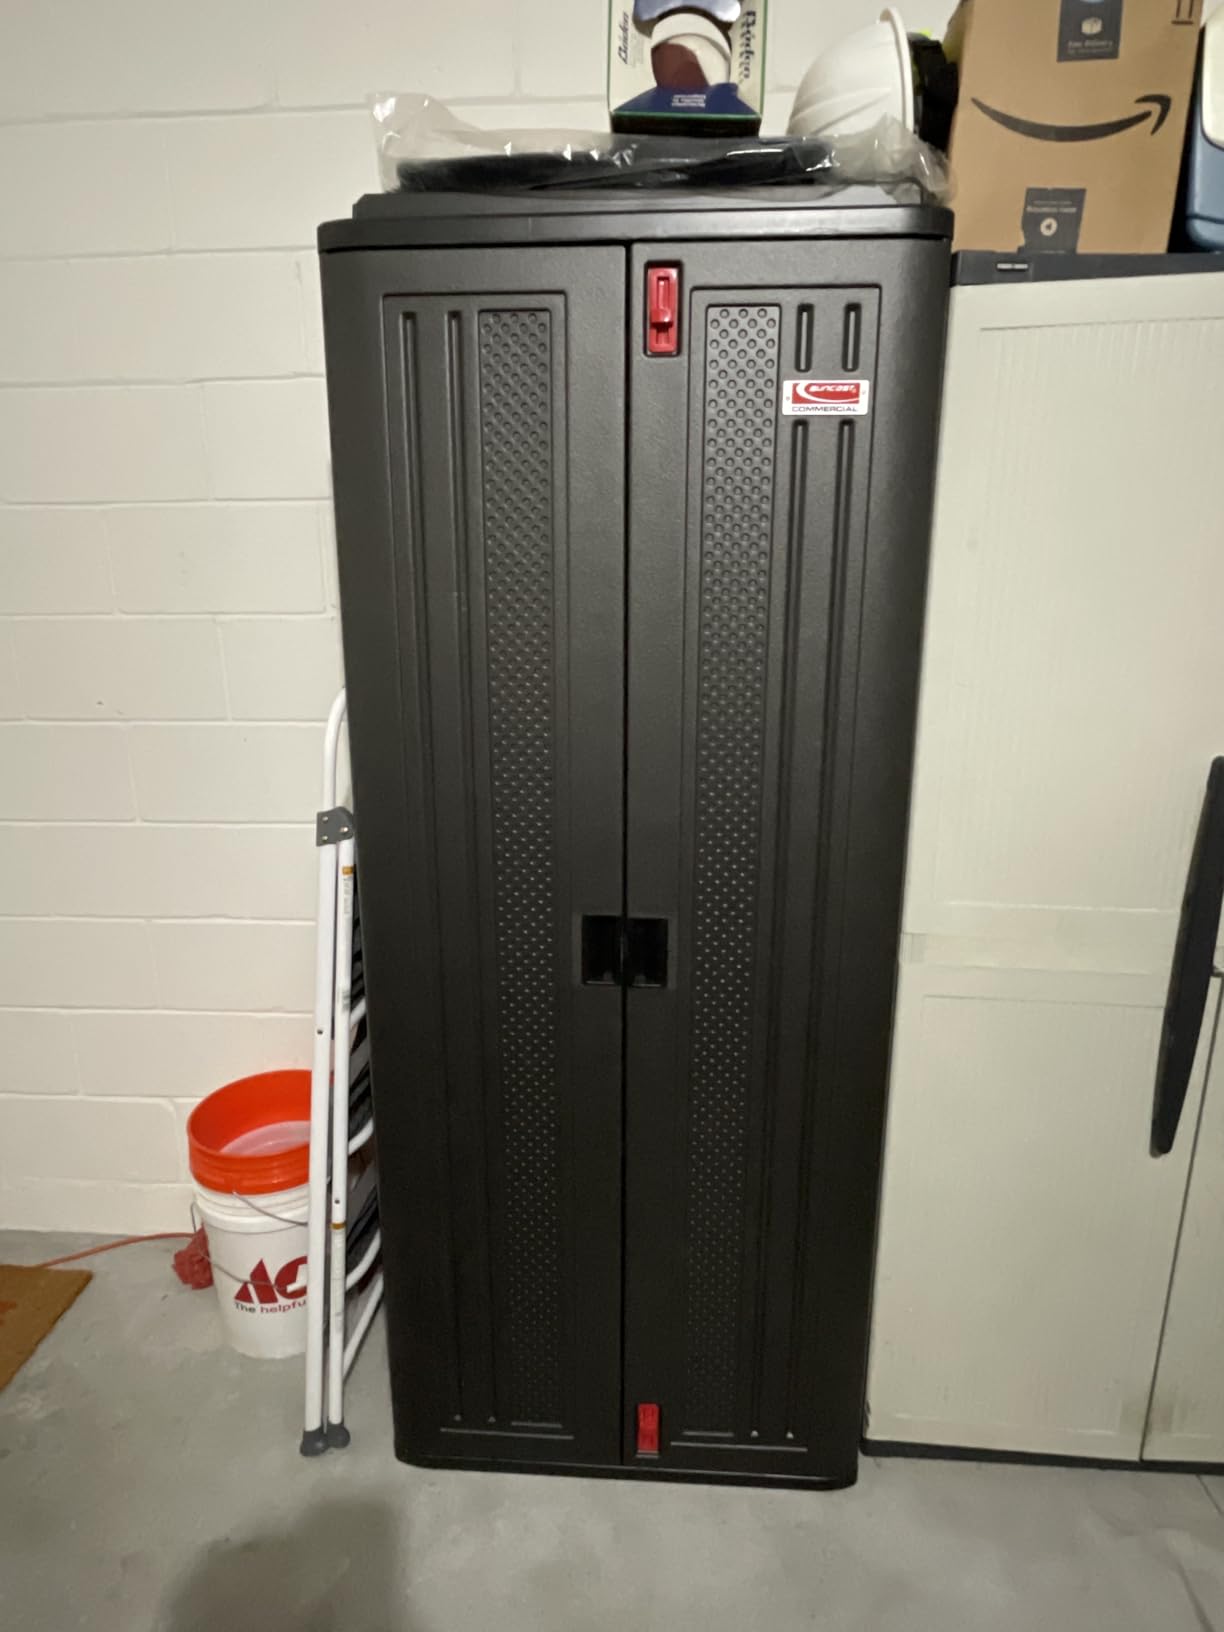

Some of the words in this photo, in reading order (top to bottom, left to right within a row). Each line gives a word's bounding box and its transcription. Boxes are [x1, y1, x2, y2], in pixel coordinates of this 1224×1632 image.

[234, 1255, 308, 1304] AC
[234, 1301, 256, 1313] The
[260, 1299, 307, 1314] helpfu
